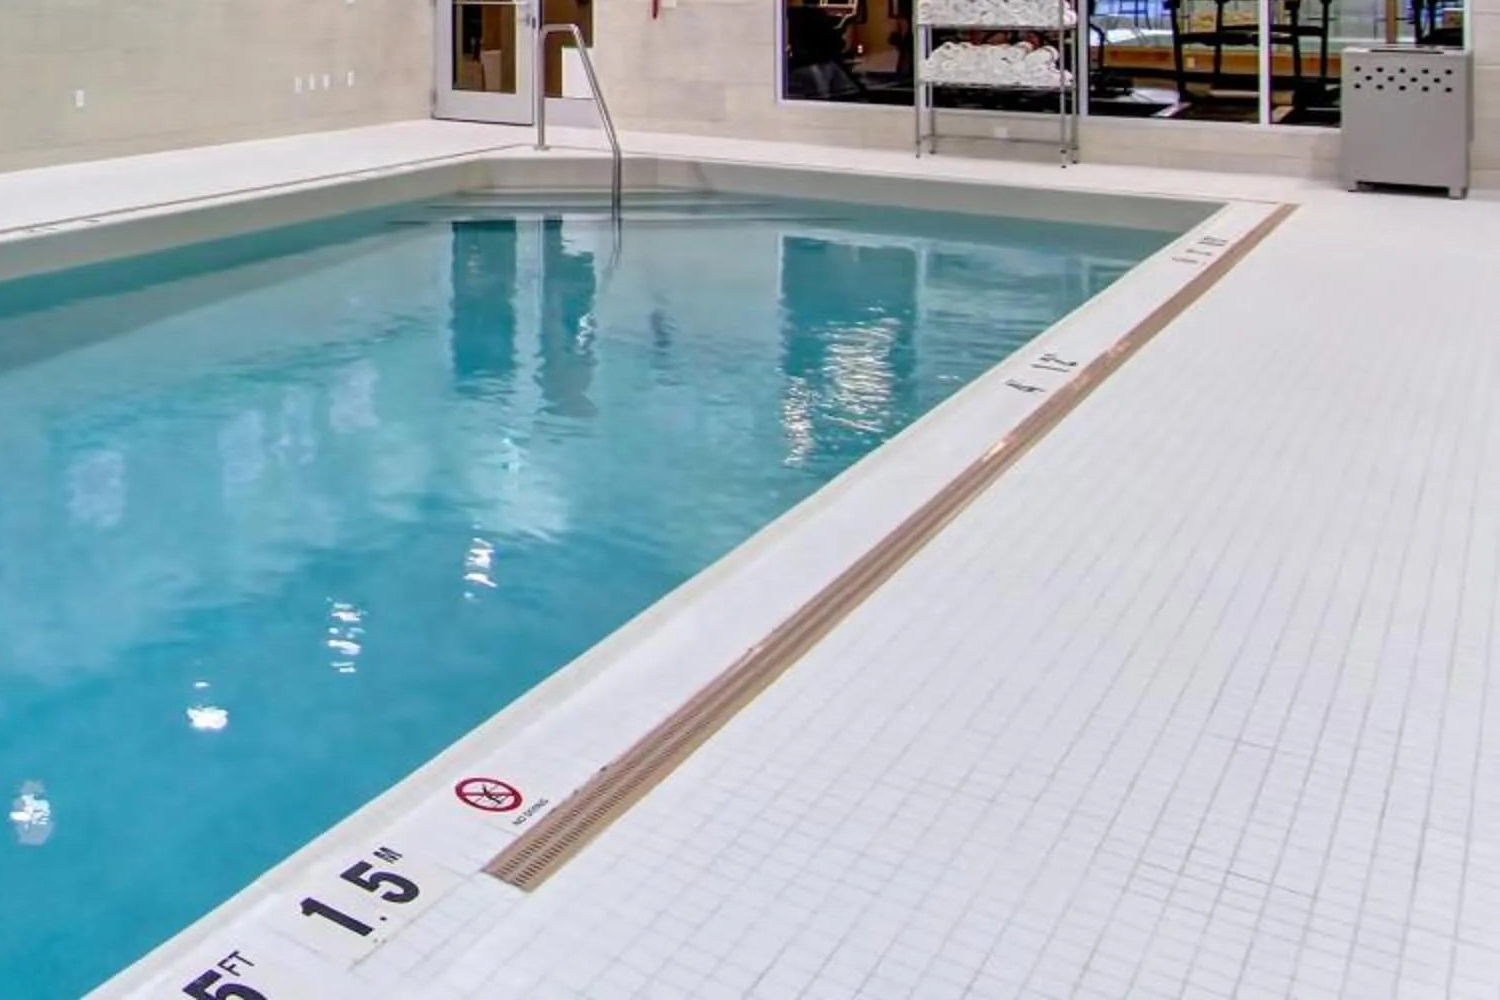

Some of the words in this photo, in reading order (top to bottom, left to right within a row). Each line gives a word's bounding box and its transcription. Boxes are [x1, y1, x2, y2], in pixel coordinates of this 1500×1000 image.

[512, 815, 526, 825] NO
[217, 950, 254, 977] FT
[300, 860, 420, 937] 1.5
[372, 846, 403, 864] M
